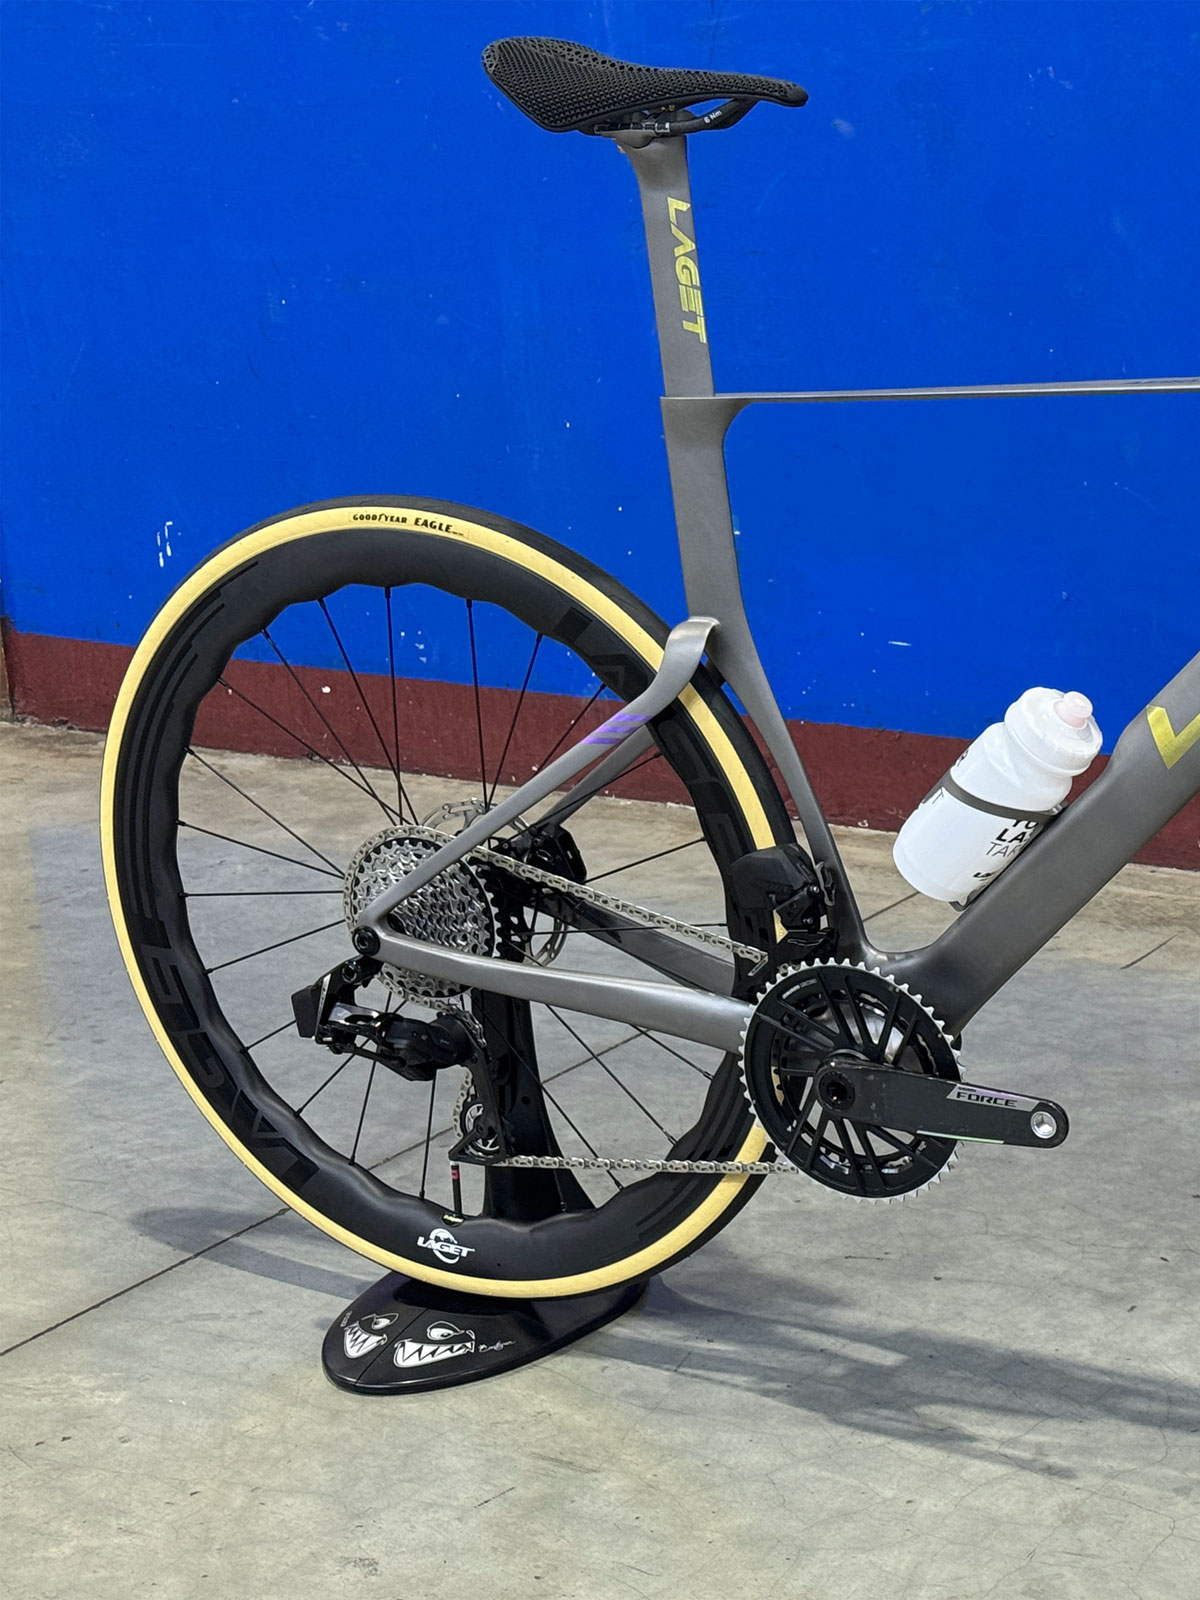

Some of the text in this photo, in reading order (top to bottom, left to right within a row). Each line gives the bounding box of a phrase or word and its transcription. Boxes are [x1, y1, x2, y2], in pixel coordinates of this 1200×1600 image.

[667, 197, 707, 344] LAGET
[413, 517, 453, 533] EAGLE
[956, 1092, 1019, 1108] FORCE
[417, 1235, 473, 1258] LAGET
